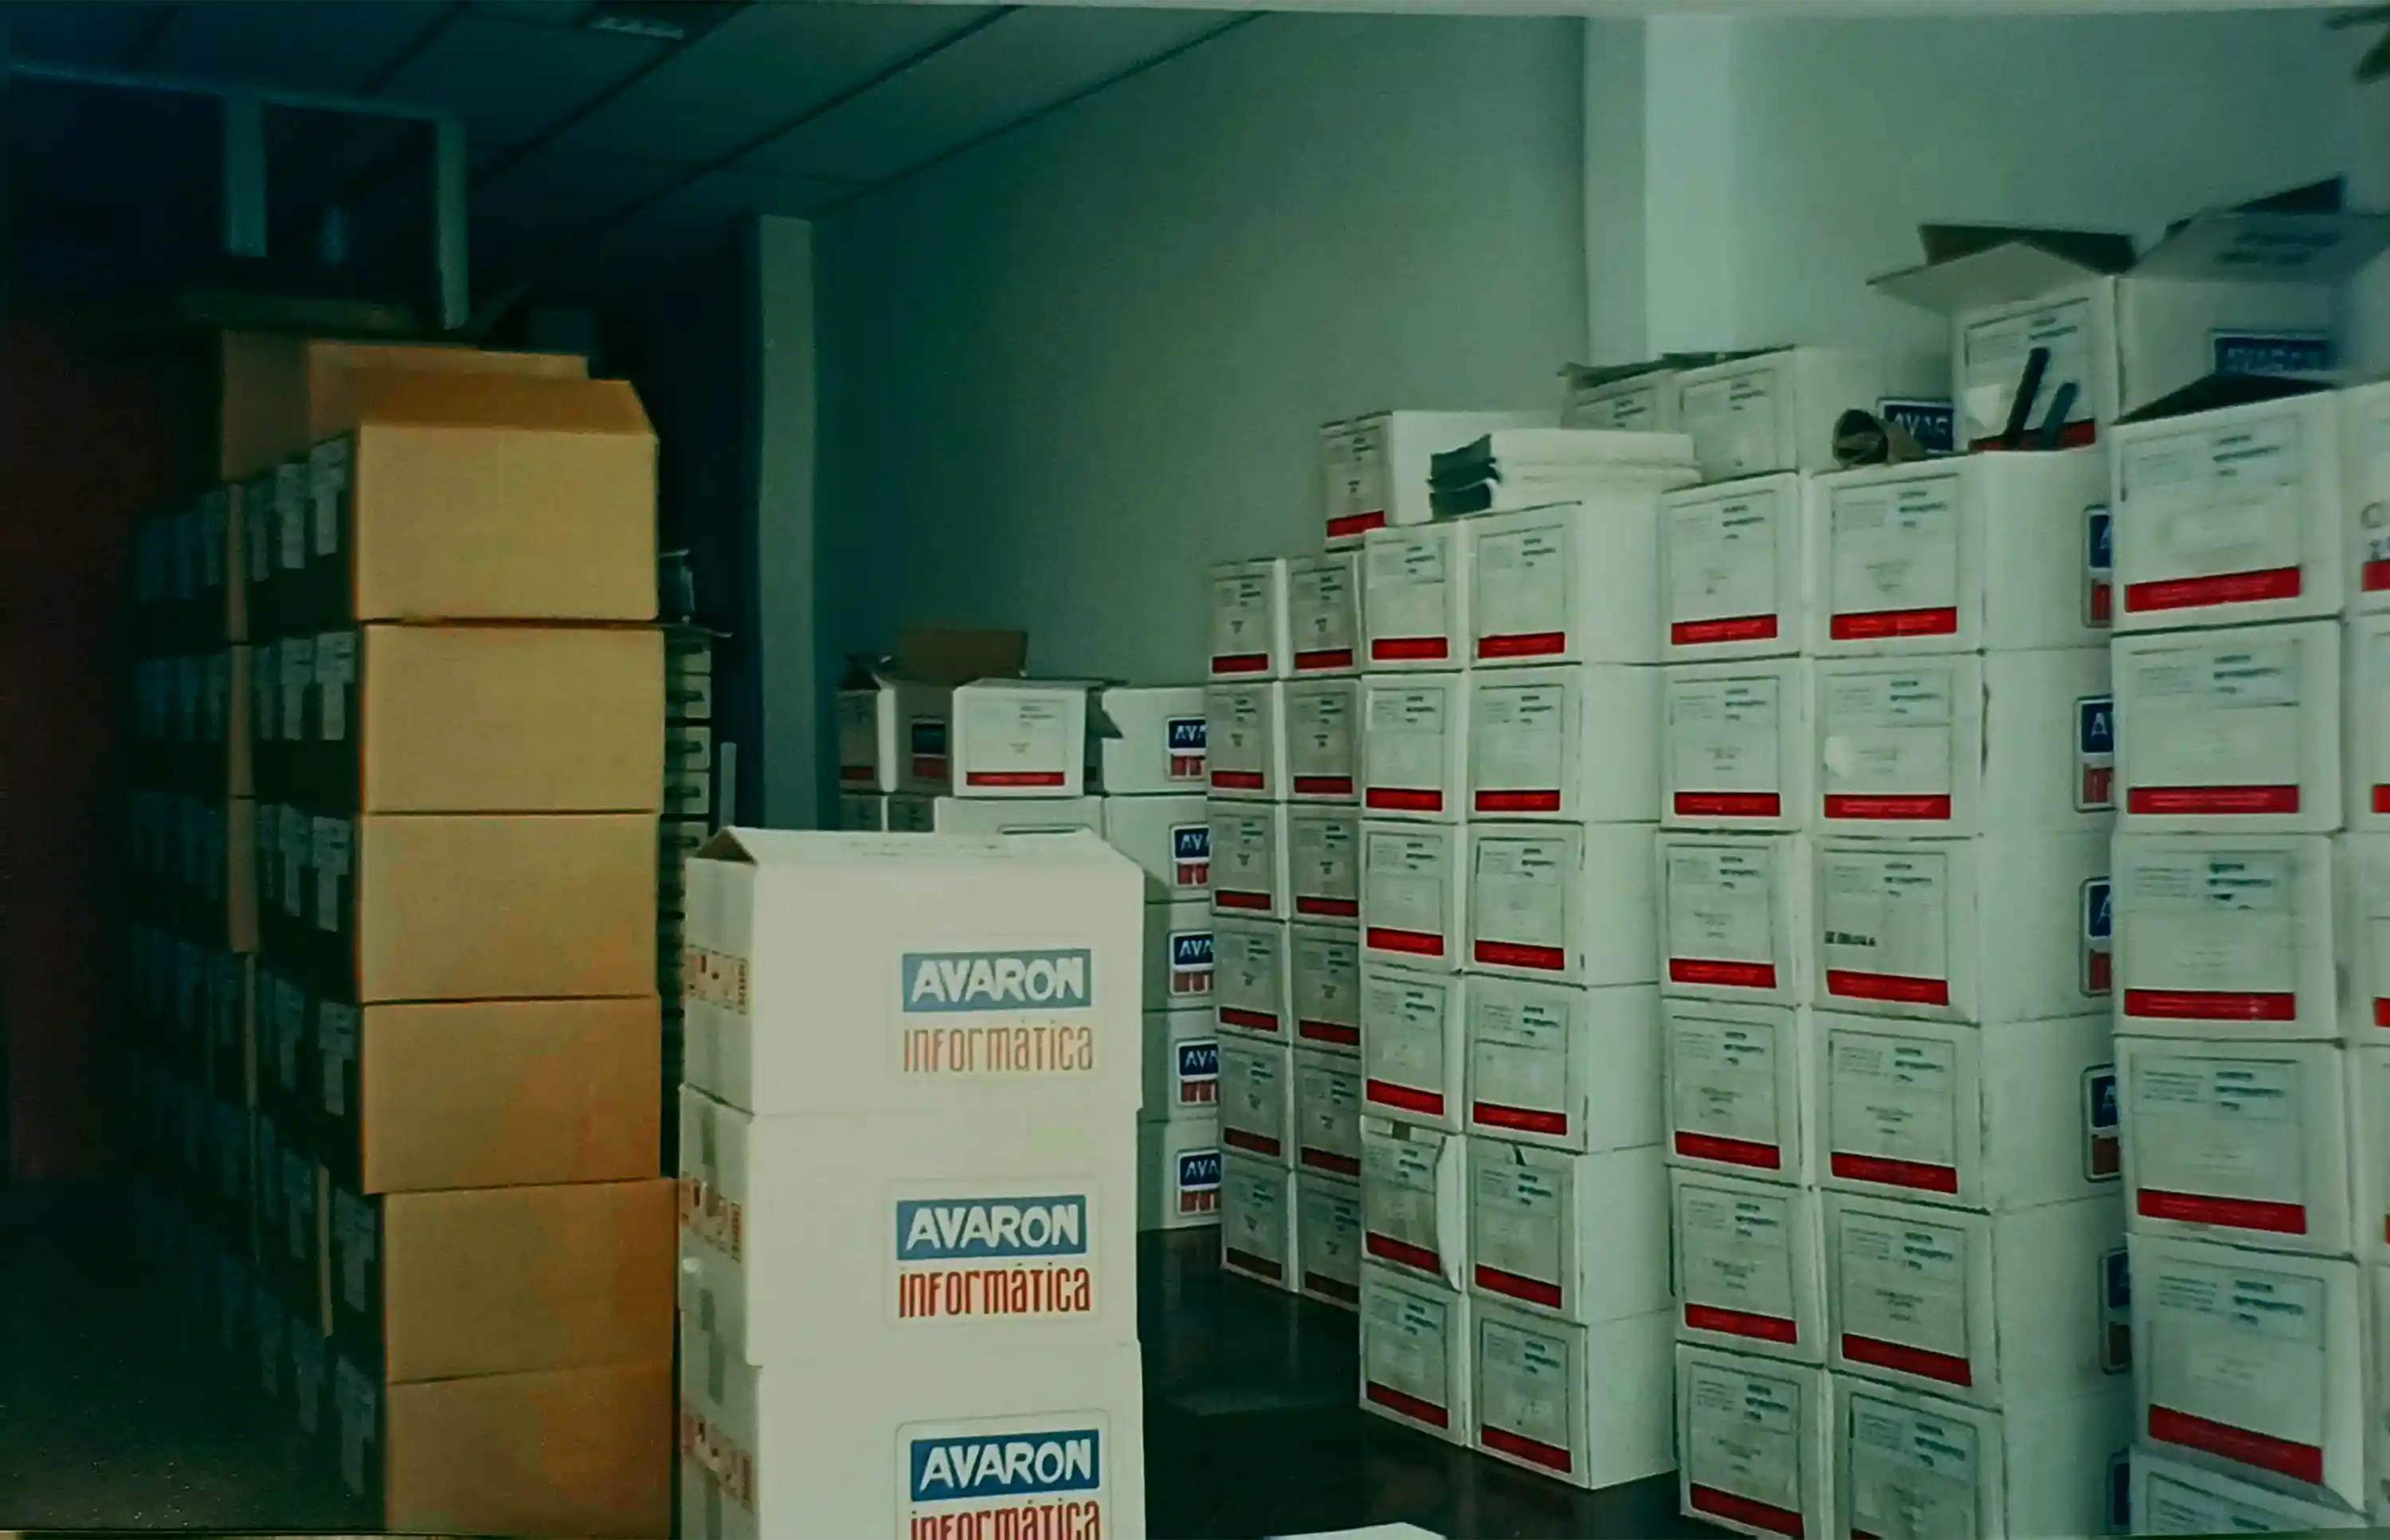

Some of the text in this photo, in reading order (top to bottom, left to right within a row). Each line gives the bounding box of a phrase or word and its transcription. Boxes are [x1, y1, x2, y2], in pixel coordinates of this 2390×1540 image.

[912, 957, 1083, 1002] AVARON
[906, 1204, 1079, 1251] AVARON
[899, 1262, 1091, 1318] informática
[920, 1438, 1091, 1492] AVARON
